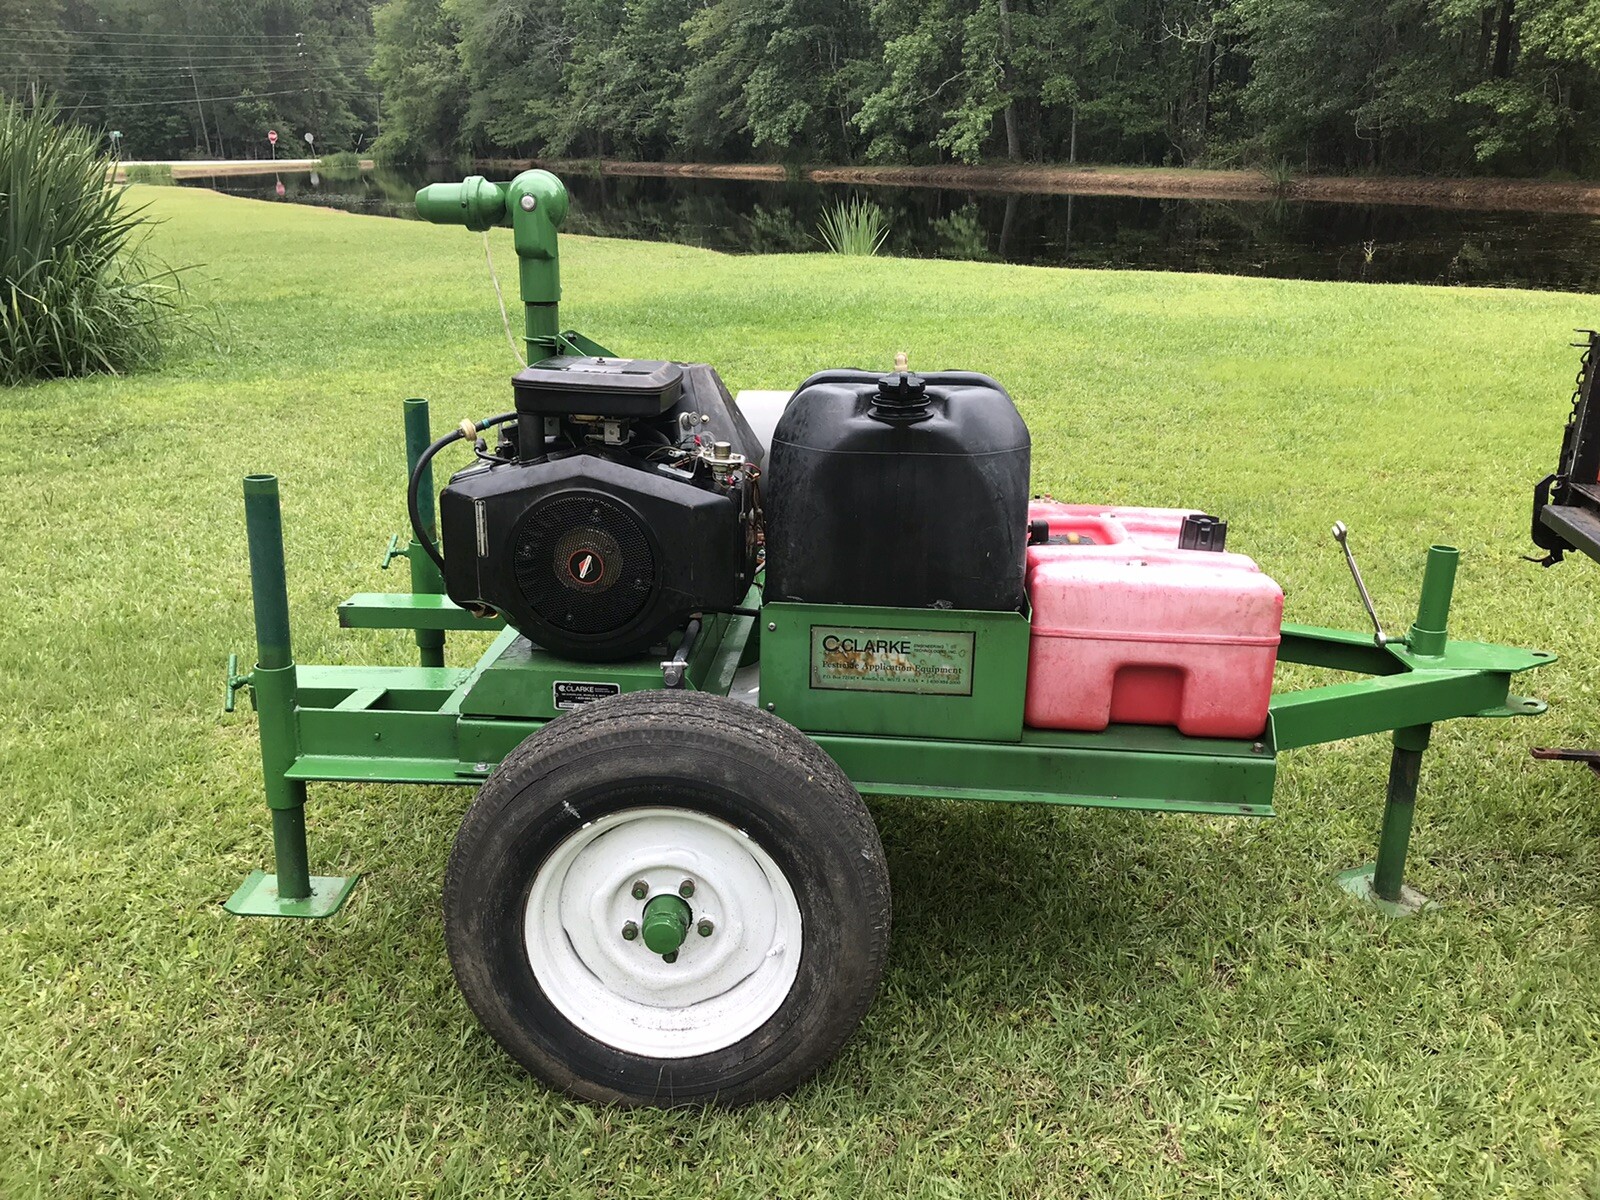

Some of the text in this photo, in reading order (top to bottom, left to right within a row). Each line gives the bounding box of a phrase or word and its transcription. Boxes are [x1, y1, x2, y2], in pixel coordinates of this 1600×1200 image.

[842, 638, 911, 654] CLARKE
[862, 662, 912, 673] Application
[914, 664, 962, 675] Equipment
